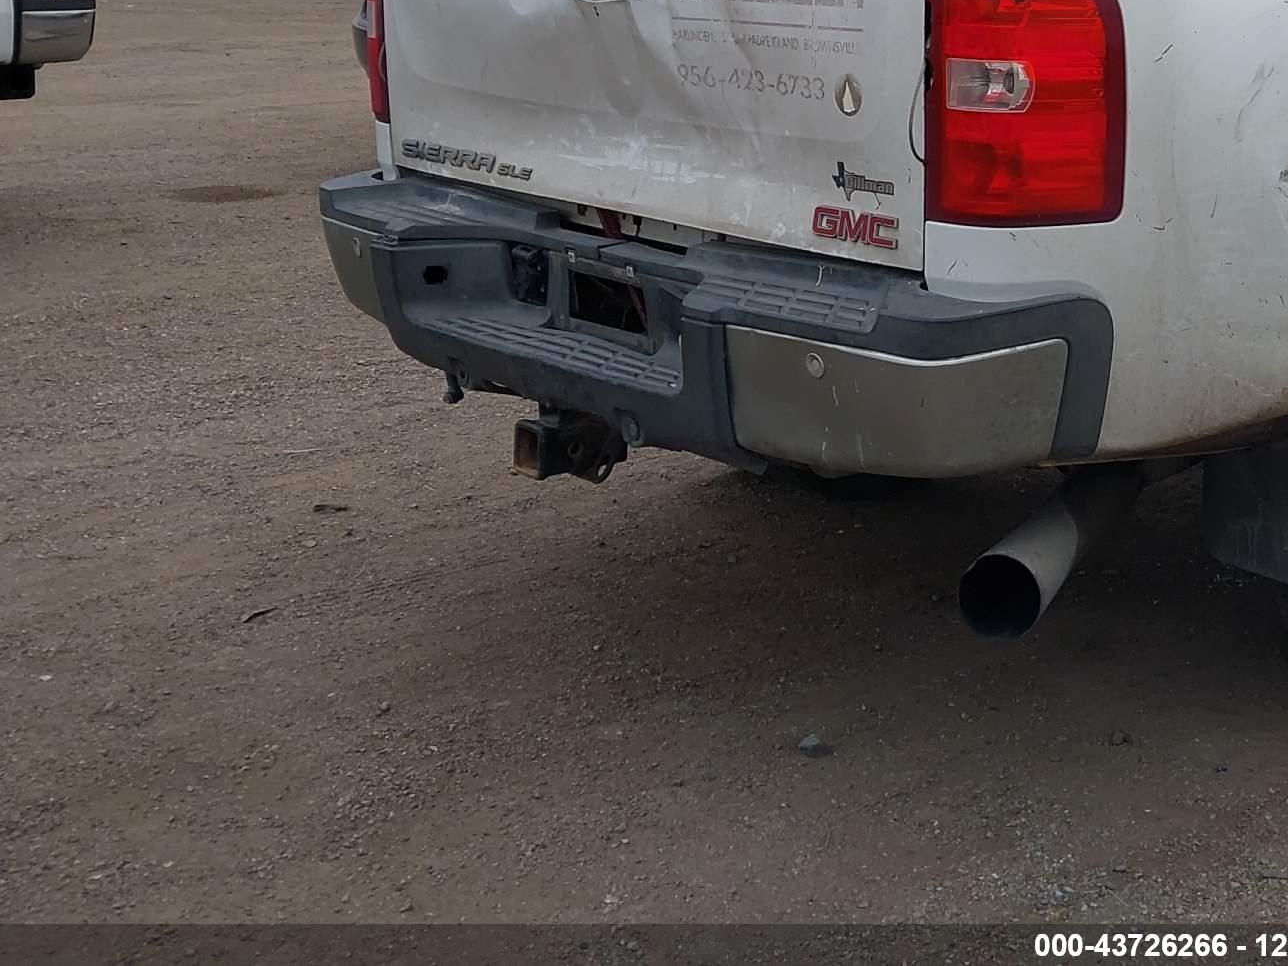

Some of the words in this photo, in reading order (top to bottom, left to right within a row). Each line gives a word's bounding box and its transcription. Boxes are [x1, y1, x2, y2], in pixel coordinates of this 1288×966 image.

[401, 138, 497, 174] SIERRA
[497, 161, 533, 181] SLE
[812, 205, 900, 250] GMC
